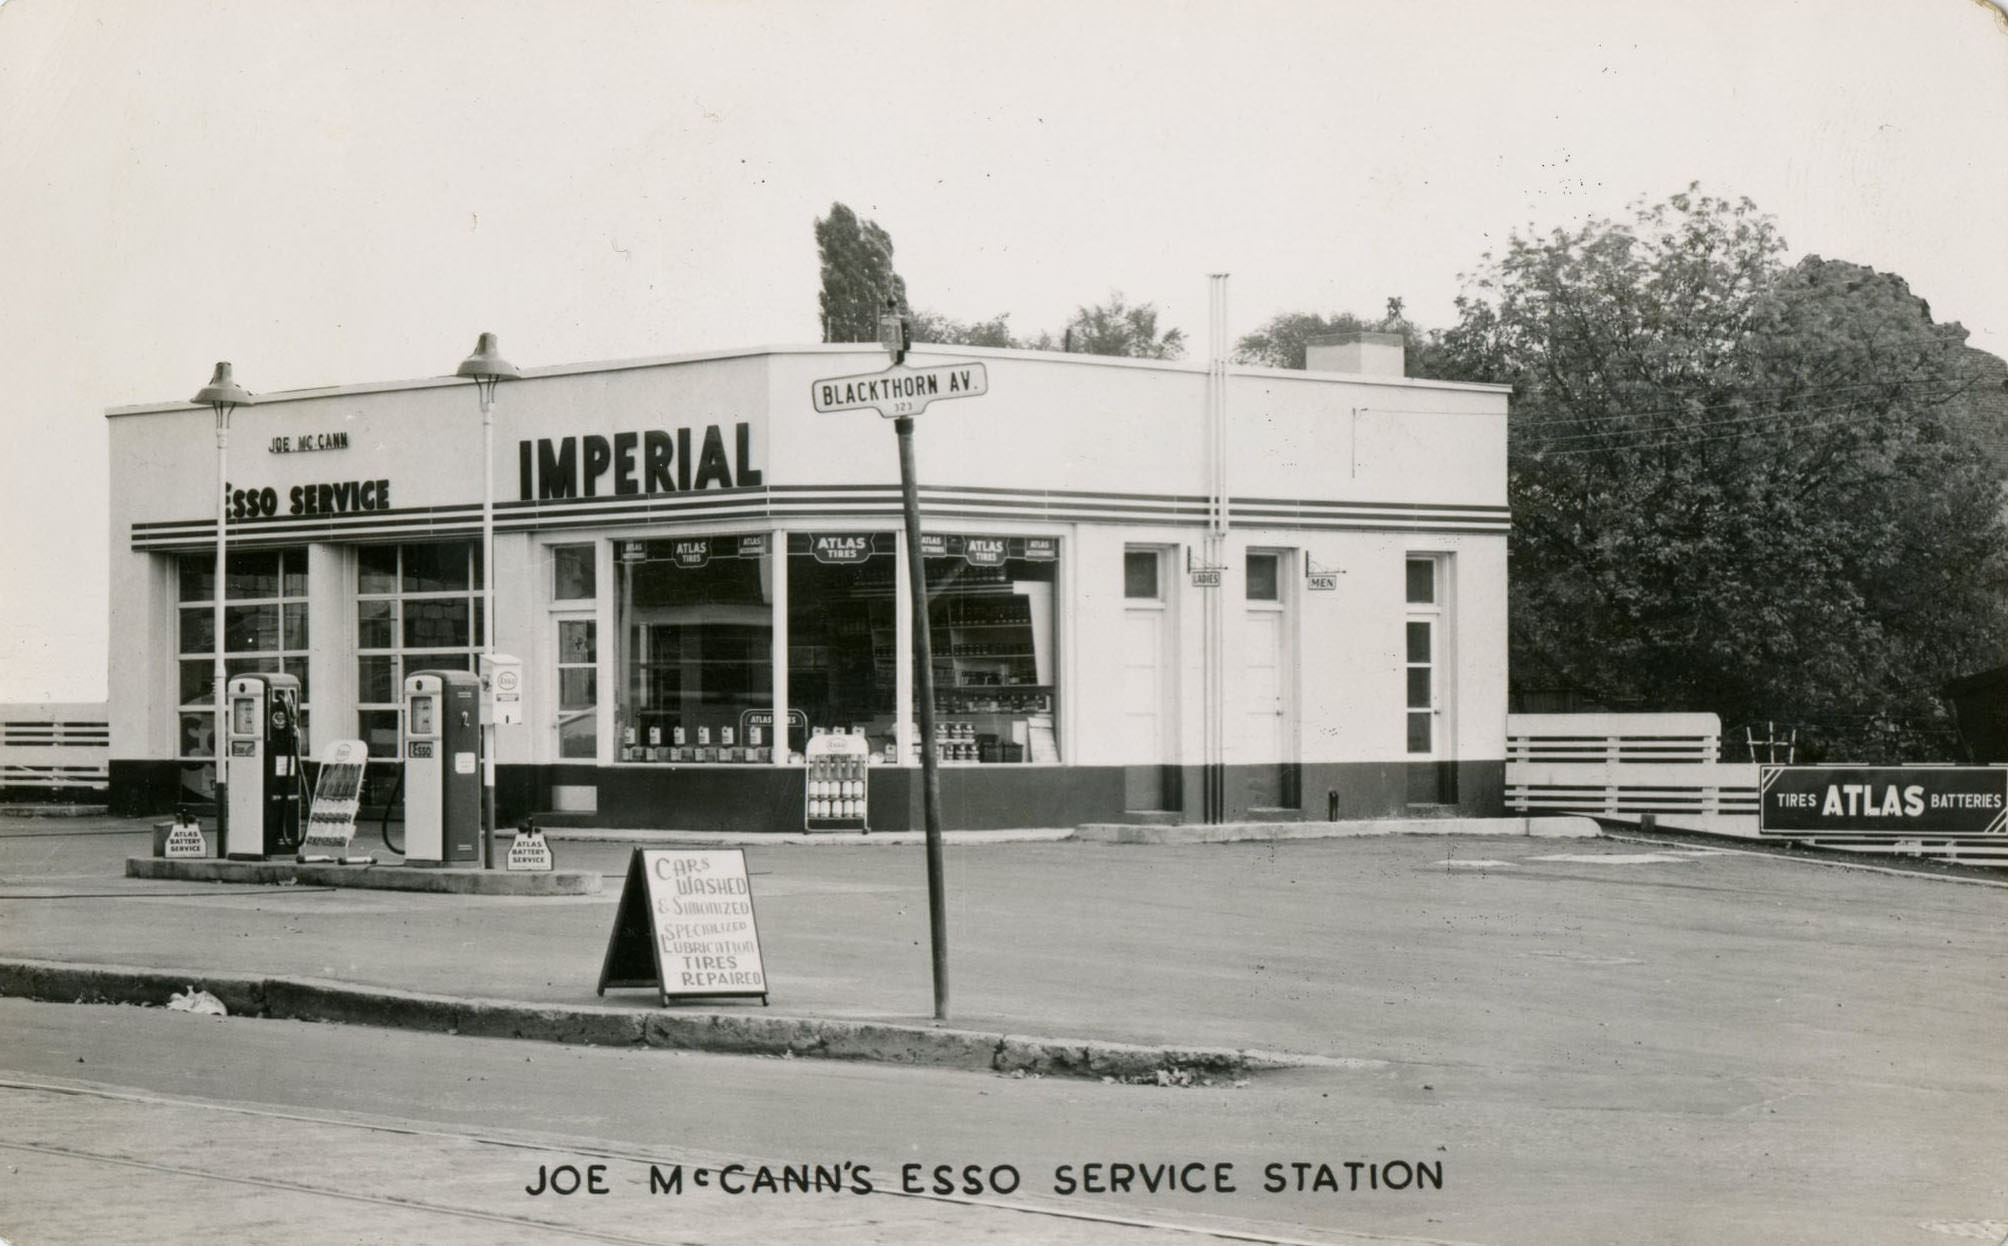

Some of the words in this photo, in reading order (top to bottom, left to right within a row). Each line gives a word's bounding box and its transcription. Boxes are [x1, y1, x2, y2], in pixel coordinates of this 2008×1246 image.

[822, 374, 938, 406] BLACKTHORN
[949, 370, 978, 393] AV.
[269, 437, 290, 453] JOE
[317, 432, 348, 450] CANN
[519, 422, 763, 501] IMPERIAL
[289, 479, 390, 515] SERVICE
[676, 542, 706, 554] ATLAS
[817, 537, 866, 550] ATLAS
[968, 540, 1004, 552] ATLAS
[682, 554, 702, 563] TIRES
[827, 549, 857, 559] TIRES
[975, 552, 997, 562] TIRES
[1193, 573, 1219, 584] LADIES
[1311, 578, 1334, 588] MEN
[750, 715, 773, 725] ATLAS
[1776, 792, 1817, 808] TIRES
[1821, 783, 1926, 817] ATLAS
[1930, 792, 2003, 809] BATTERIES
[173, 830, 199, 838] ATLAS
[655, 857, 711, 880] CARS
[677, 876, 748, 895] WASHED
[657, 897, 670, 914] &
[682, 956, 738, 970] TIRES
[682, 970, 762, 987] REPAIRED
